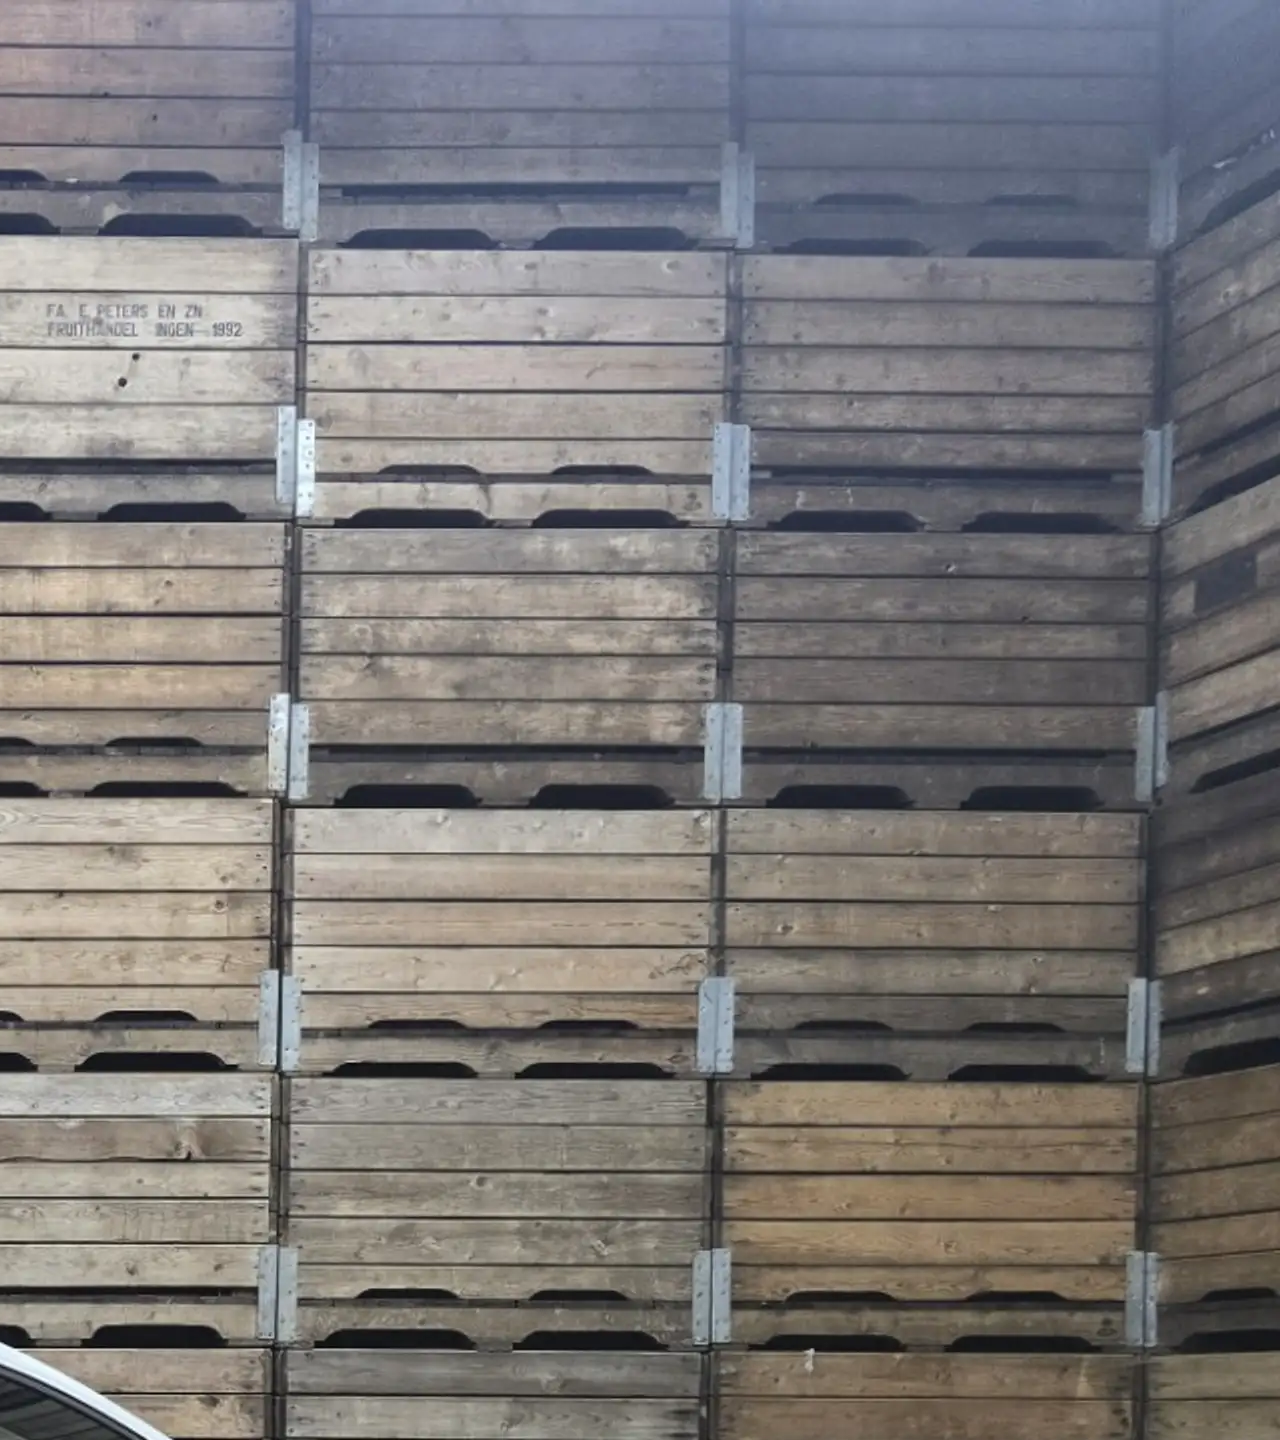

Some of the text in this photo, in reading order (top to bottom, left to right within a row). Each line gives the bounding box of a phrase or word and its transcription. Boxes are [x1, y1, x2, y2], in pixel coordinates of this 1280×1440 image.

[97, 304, 149, 319] PETERS
[158, 305, 176, 319] EN
[185, 305, 203, 319] ZN
[47, 322, 244, 337] FRUITHANDEL INGEN 1992
